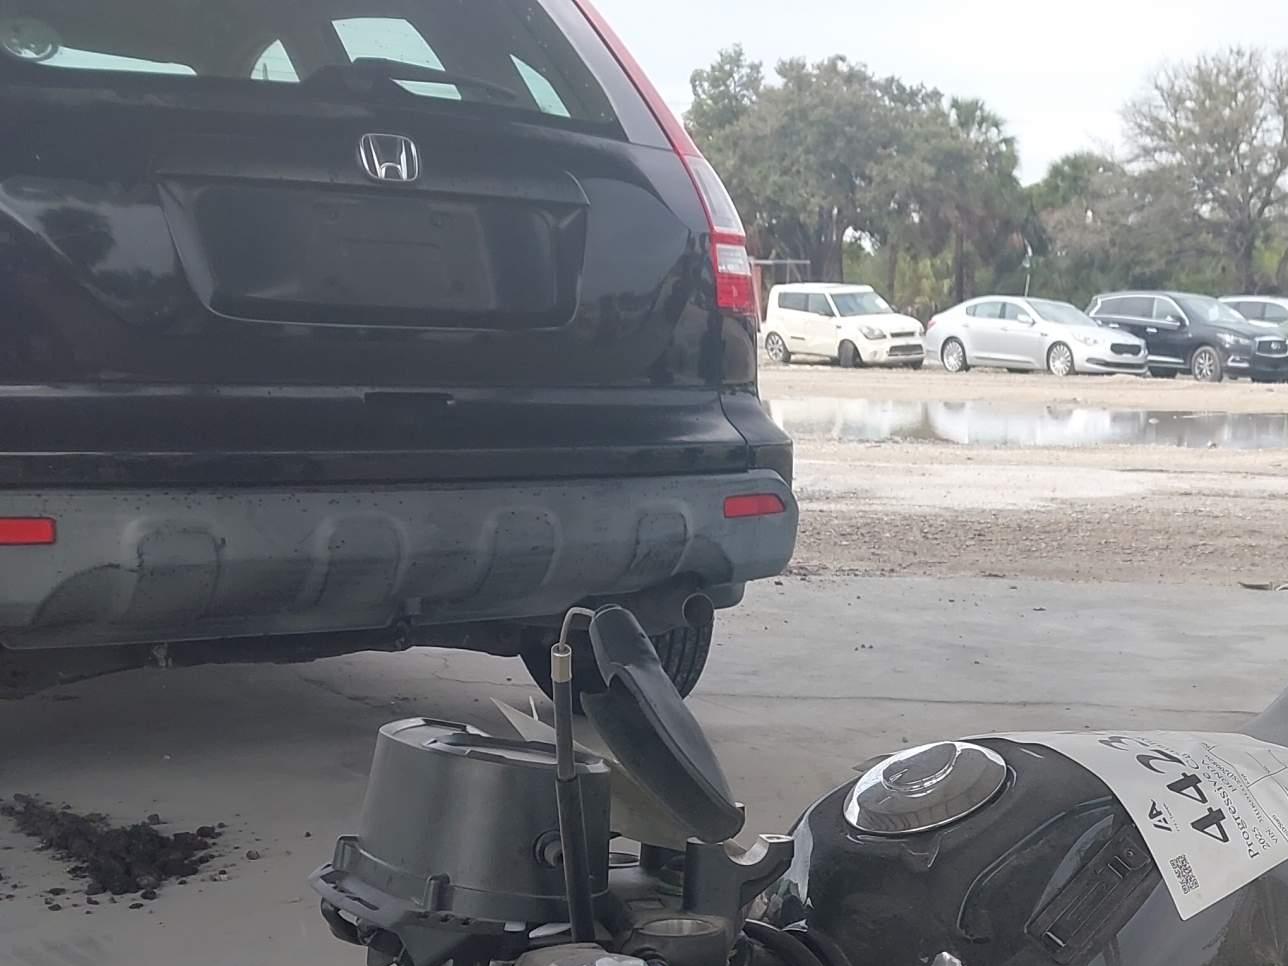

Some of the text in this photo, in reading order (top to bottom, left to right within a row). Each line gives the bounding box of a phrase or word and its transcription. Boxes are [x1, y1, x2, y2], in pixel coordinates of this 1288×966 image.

[1099, 736, 1229, 843] 4423
[1201, 759, 1238, 792] HONDA
[1202, 771, 1260, 858] Progressive
[1253, 826, 1271, 850] 2025
